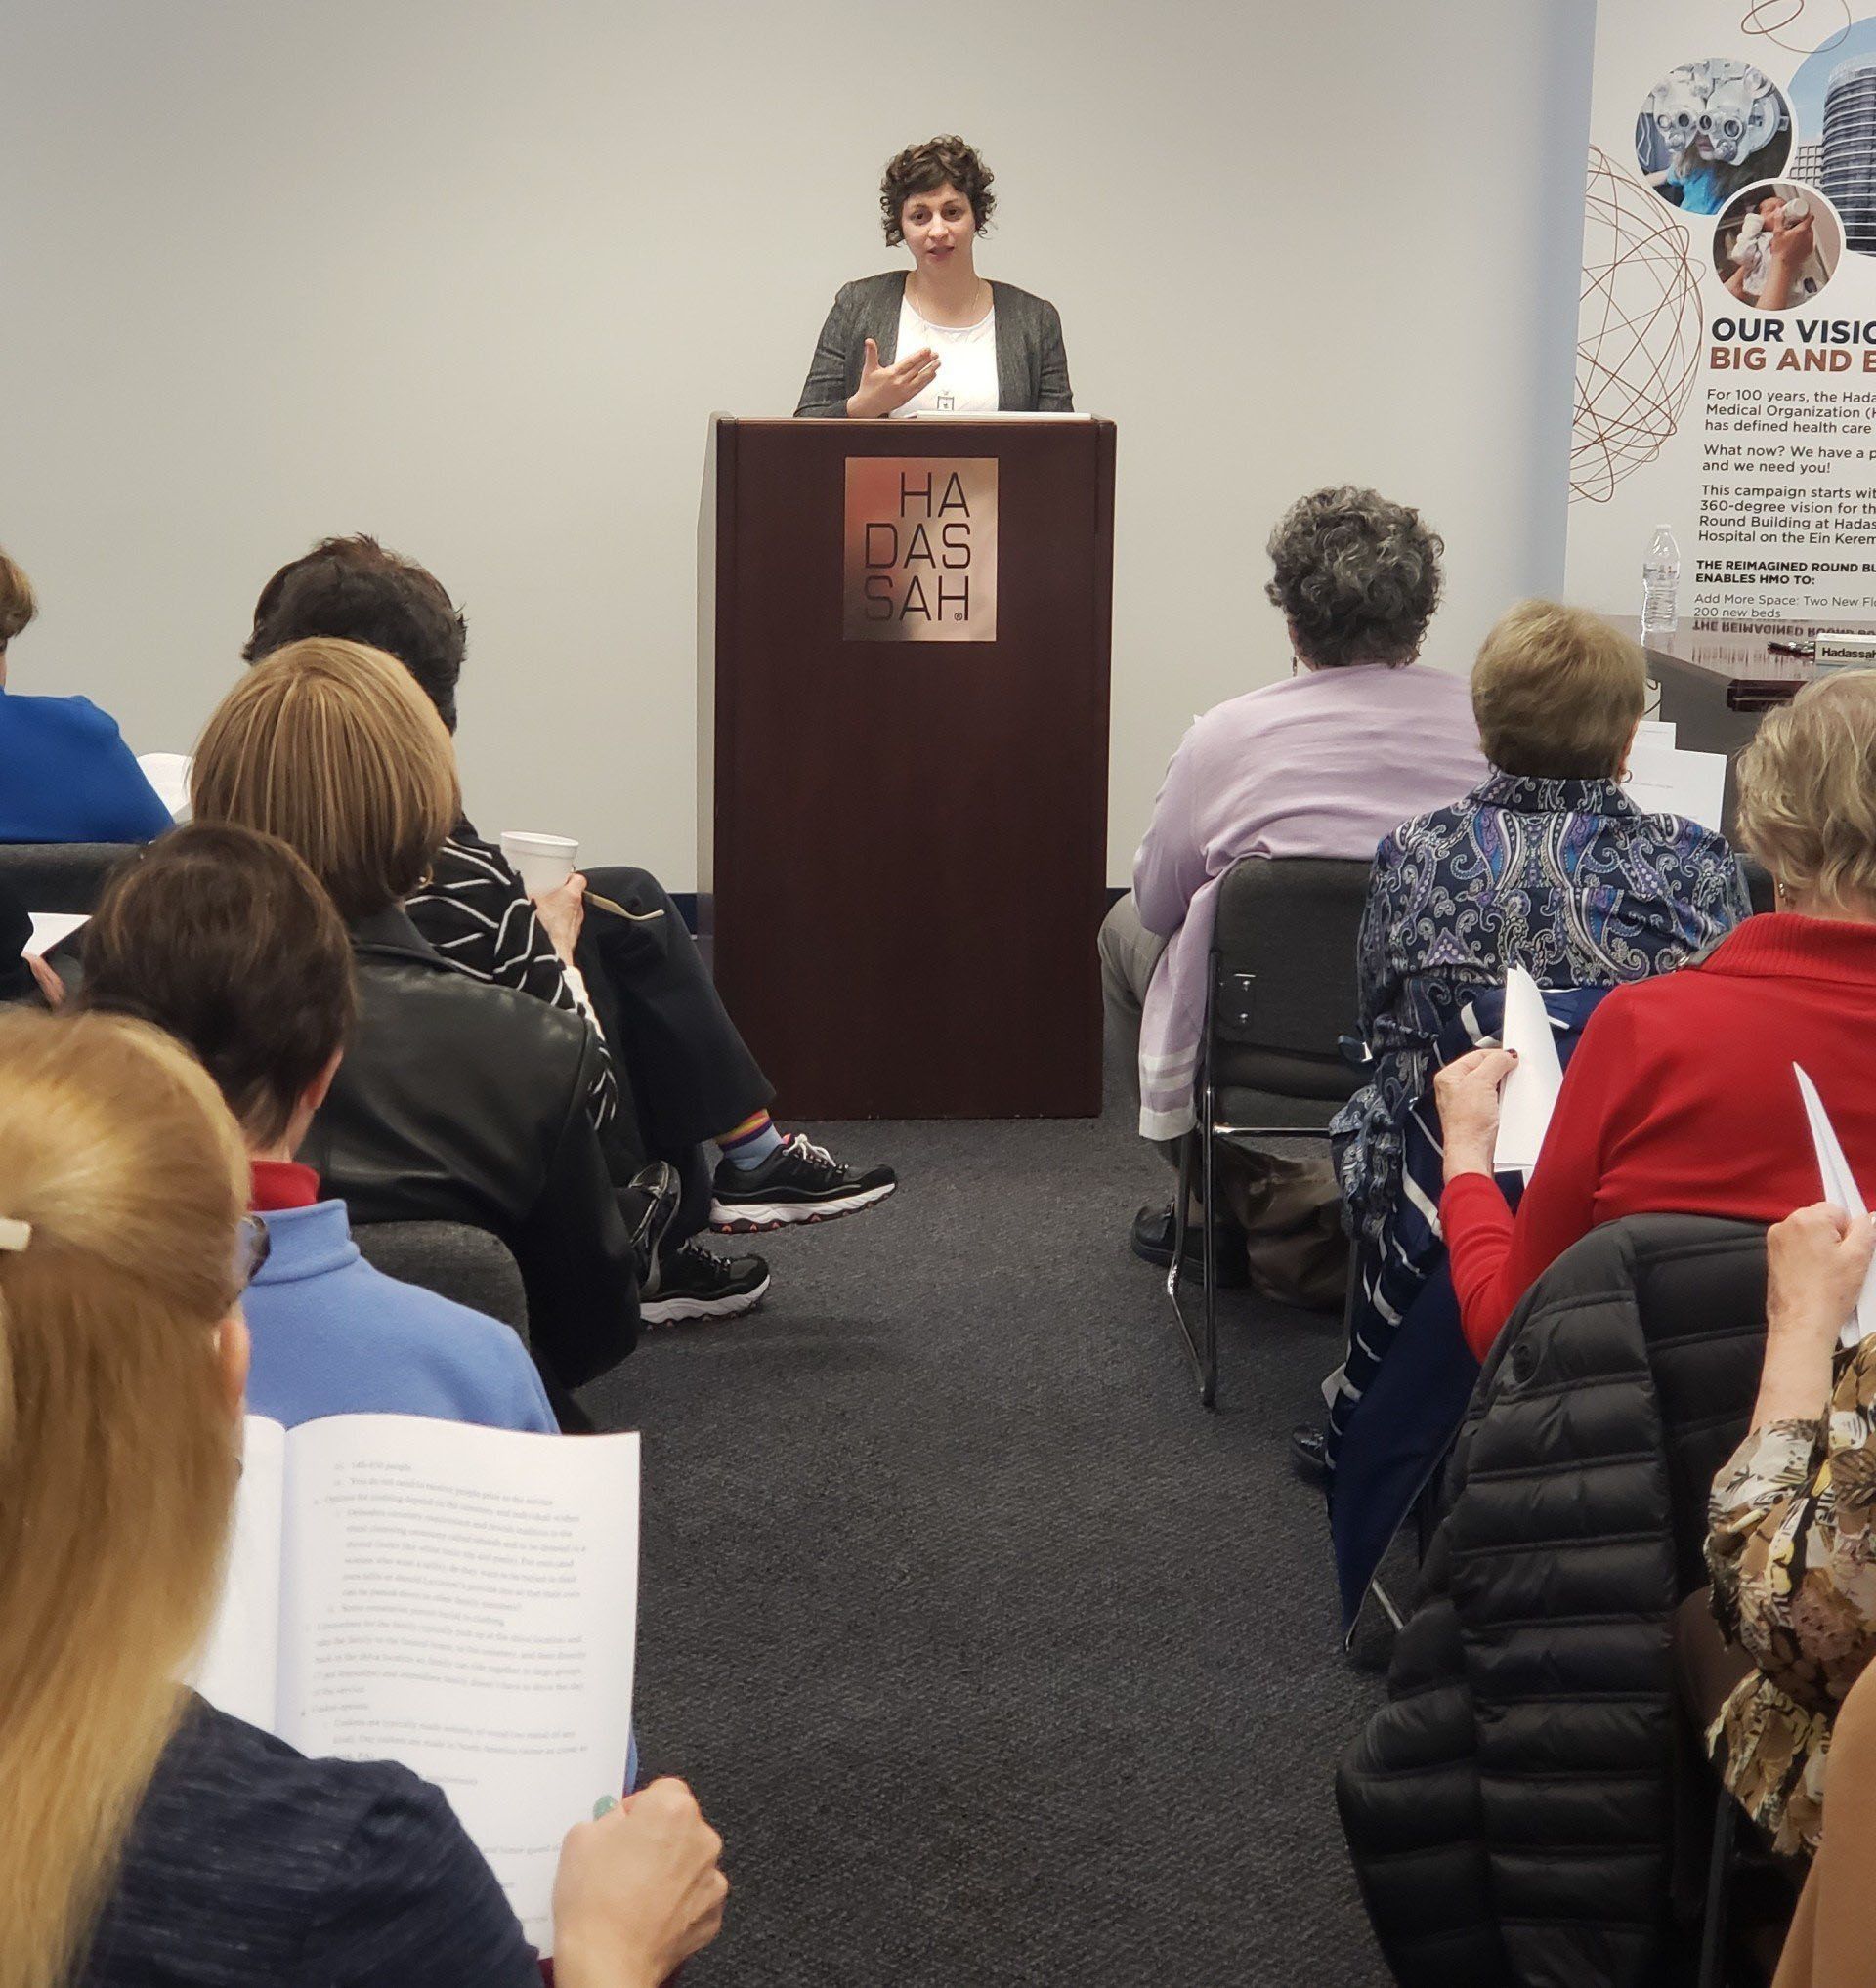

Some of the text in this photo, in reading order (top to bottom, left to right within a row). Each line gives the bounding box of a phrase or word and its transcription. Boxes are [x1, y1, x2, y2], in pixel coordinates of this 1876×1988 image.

[1712, 317, 1784, 342] OUR
[1710, 347, 1766, 370] BIG
[1776, 348, 1852, 372] AND
[1707, 389, 1731, 400] For
[1736, 390, 1762, 401] 100
[1767, 391, 1809, 403] years,
[1814, 392, 1838, 402] the
[1706, 403, 1762, 416] Medical
[1767, 404, 1859, 418] Organization
[1705, 419, 1872, 434] has defined health care
[1704, 444, 1742, 456] What
[1747, 445, 1785, 456] now?
[1790, 446, 1813, 458] We
[1818, 446, 1852, 458] have
[1702, 460, 1729, 471] and
[1759, 461, 1795, 472] need
[1800, 462, 1831, 475] you!
[900, 472, 970, 518] HA
[1701, 485, 1730, 496] This
[1735, 486, 1806, 499] campaign
[1811, 487, 1851, 498] starts
[1700, 500, 1786, 513] 360-degree
[1791, 502, 1833, 513] vision
[1838, 503, 1857, 514] for
[1699, 516, 1746, 527] Round
[1751, 516, 1811, 529] Building
[1815, 519, 1830, 529] at
[1698, 530, 1756, 543] Hospital
[1760, 533, 1777, 542] on
[1782, 532, 1805, 543] the
[1810, 532, 1830, 544] Ein
[865, 523, 971, 569] DAS
[1696, 560, 1722, 570] THE
[1726, 561, 1808, 571] REIMAGINED
[1812, 563, 1858, 572] ROUND
[1695, 573, 1815, 585] ENABLES HMO TO:
[1694, 594, 1720, 604] Add
[1724, 595, 1755, 605] More
[1759, 596, 1799, 606] Space:
[1804, 596, 1828, 606] Two
[1832, 597, 1859, 607] New
[1694, 608, 1718, 616] 200
[1751, 609, 1781, 618] beds
